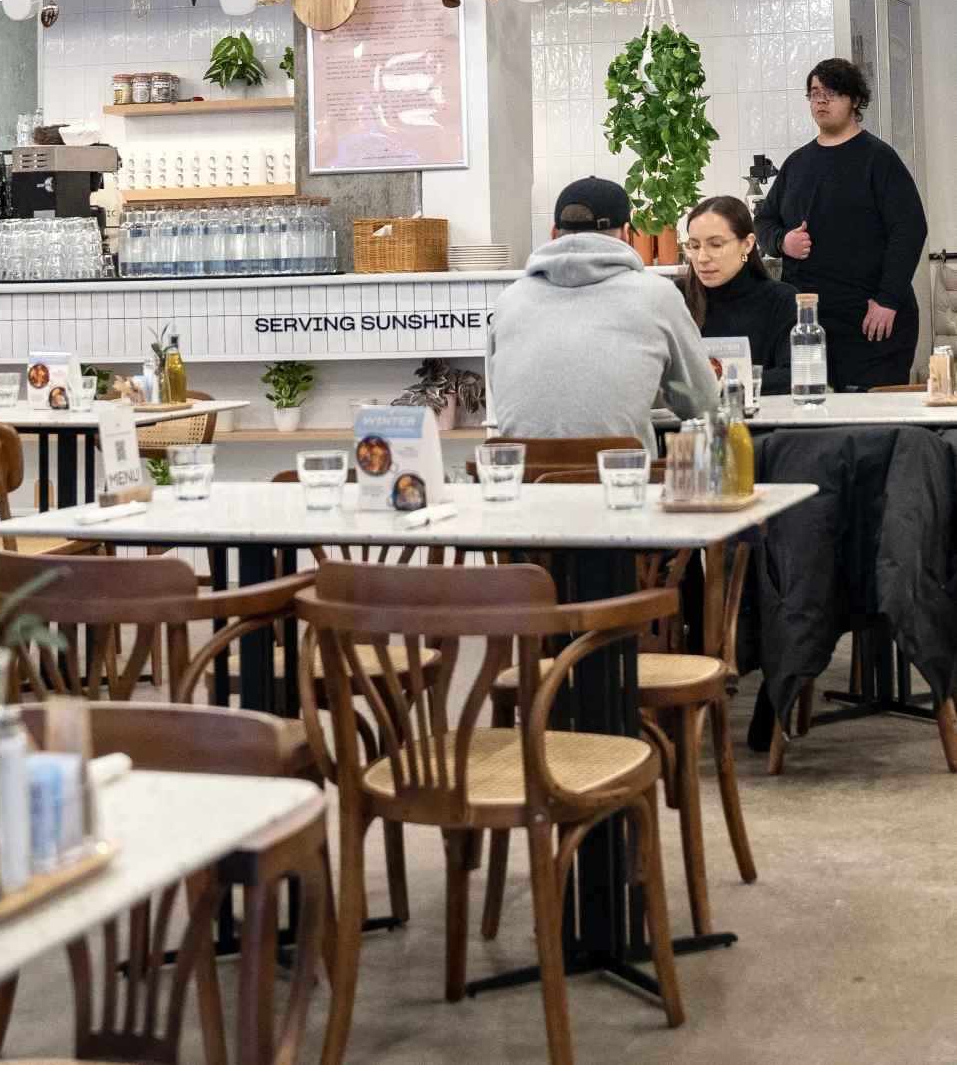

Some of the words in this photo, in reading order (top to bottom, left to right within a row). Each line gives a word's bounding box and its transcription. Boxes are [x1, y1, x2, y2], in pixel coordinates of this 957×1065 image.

[255, 316, 356, 333] SERVING
[361, 313, 481, 331] SUNSHINE
[363, 416, 417, 426] WINTER
[109, 468, 140, 486] MENU
